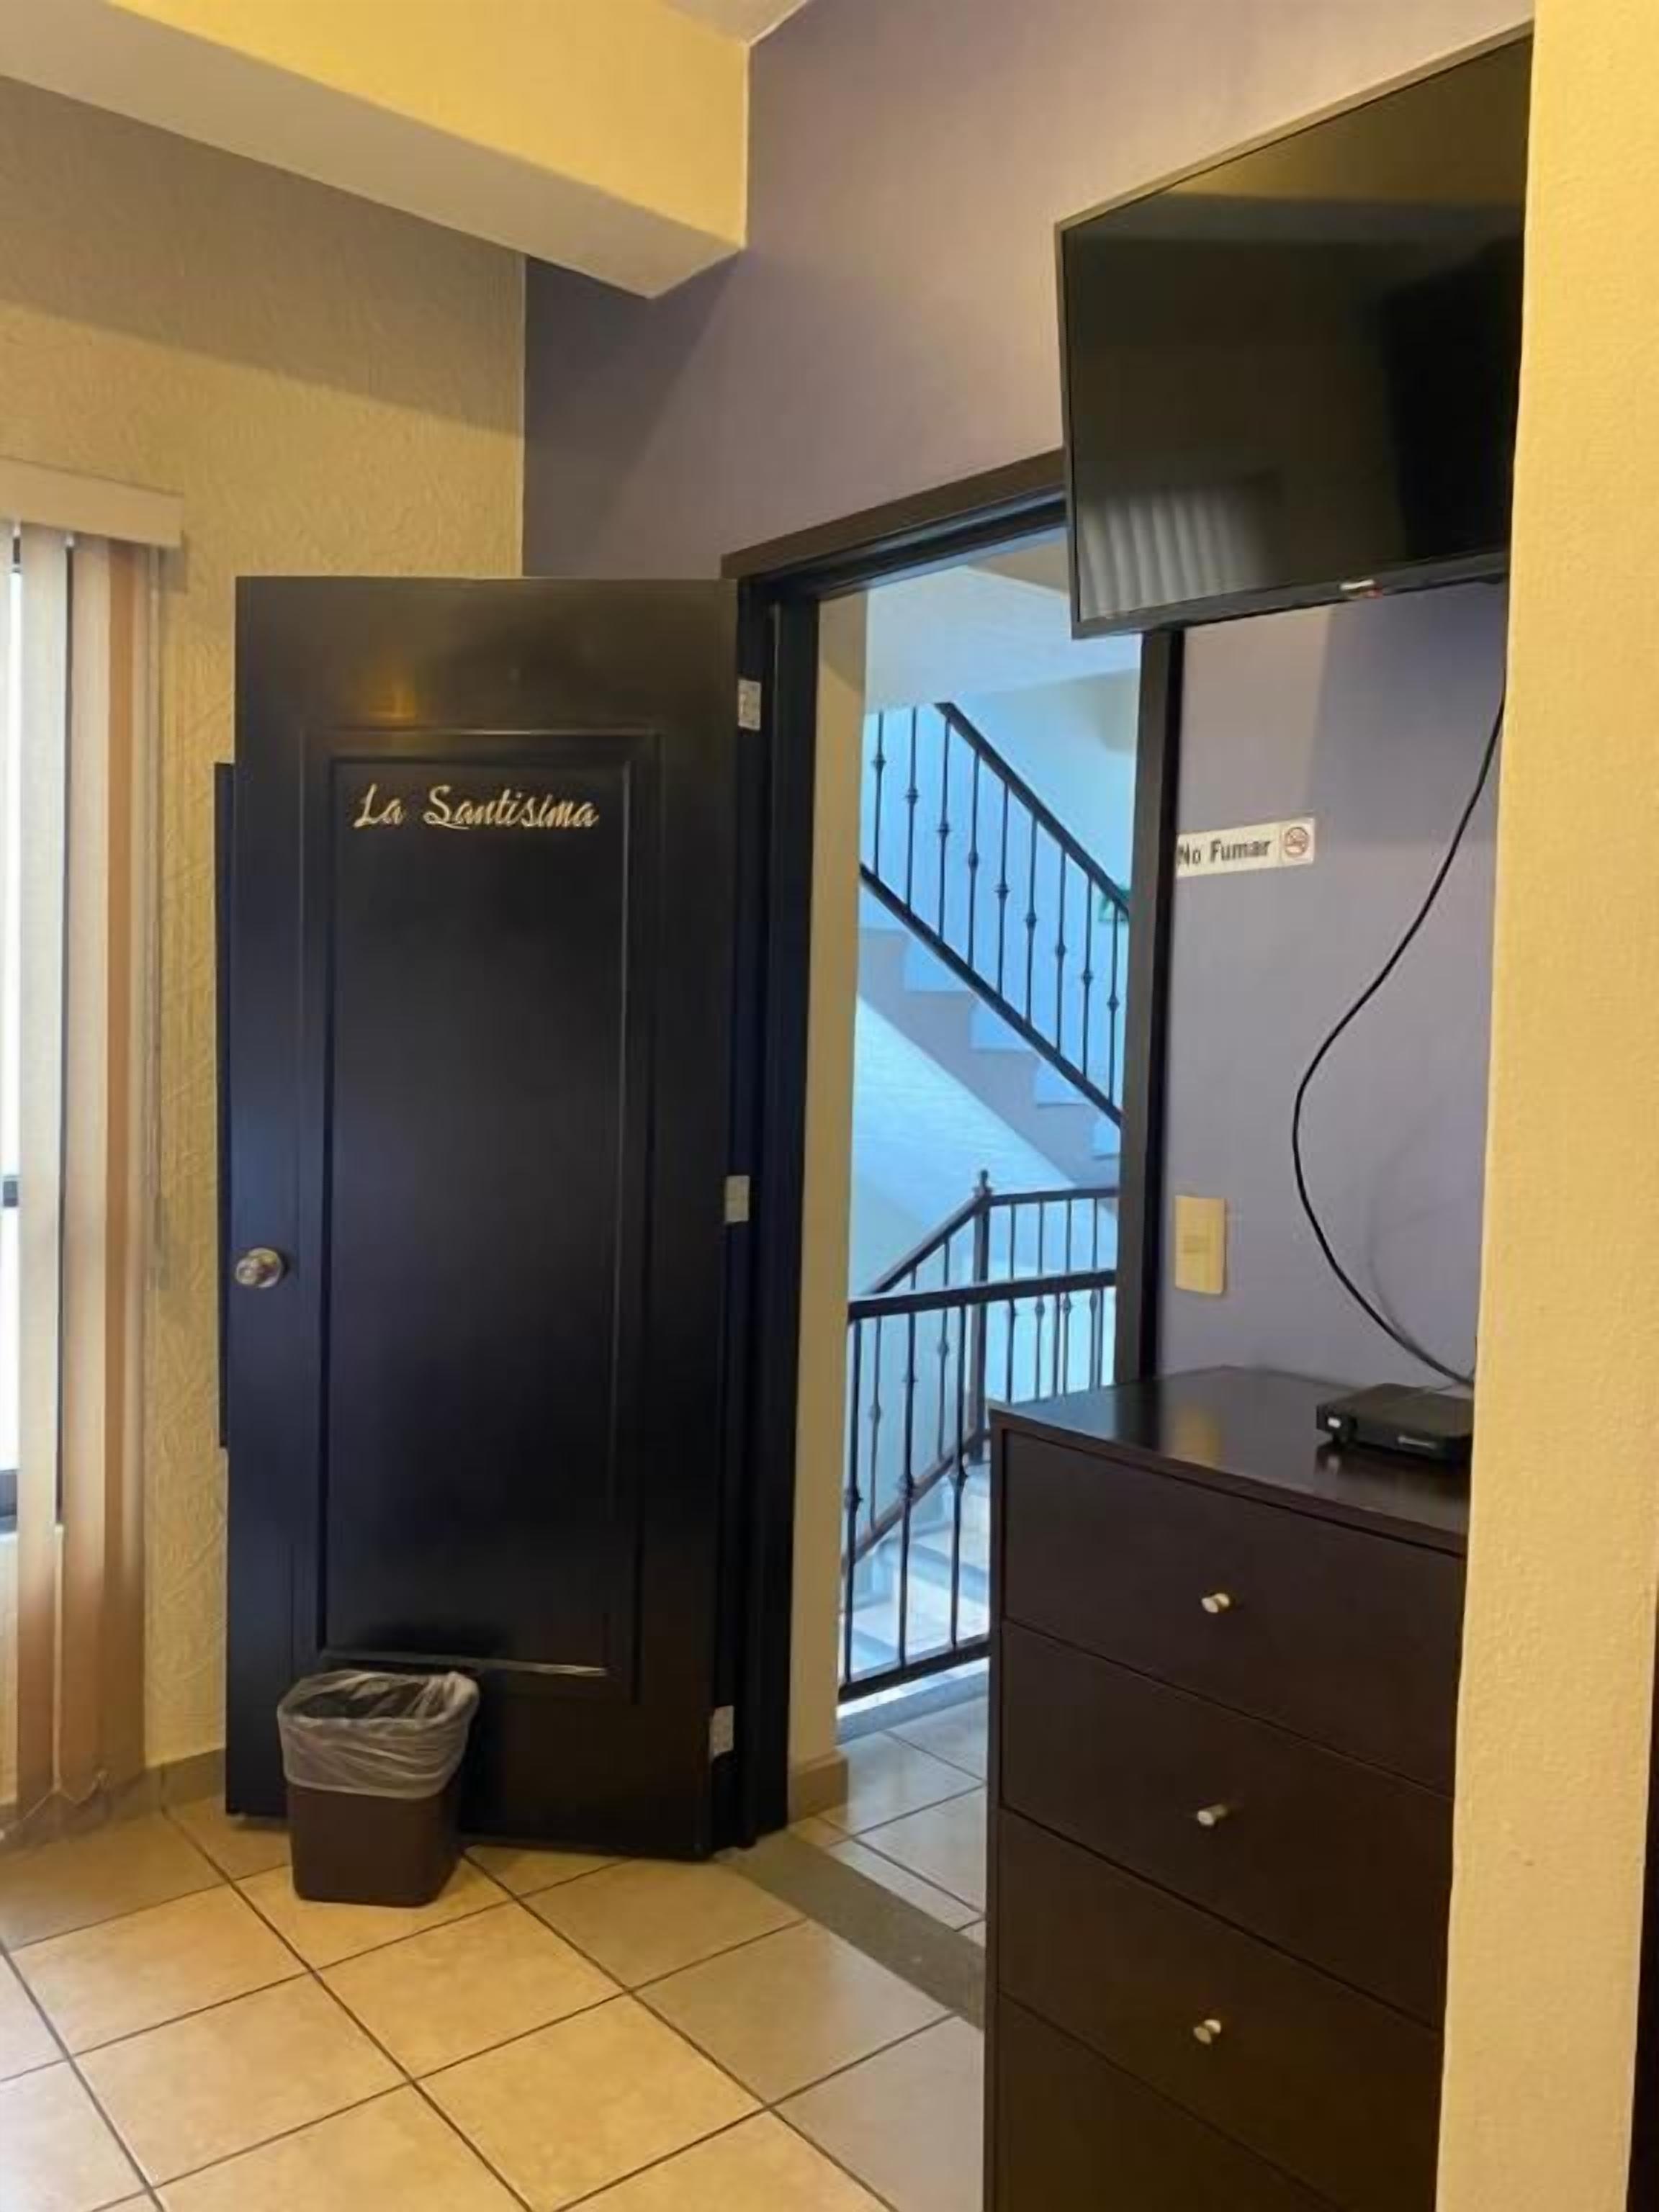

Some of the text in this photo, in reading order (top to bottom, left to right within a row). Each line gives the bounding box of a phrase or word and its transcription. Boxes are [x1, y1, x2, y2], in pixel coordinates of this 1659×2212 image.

[354, 783, 403, 828] La
[1177, 839, 1272, 866] No Fumar
